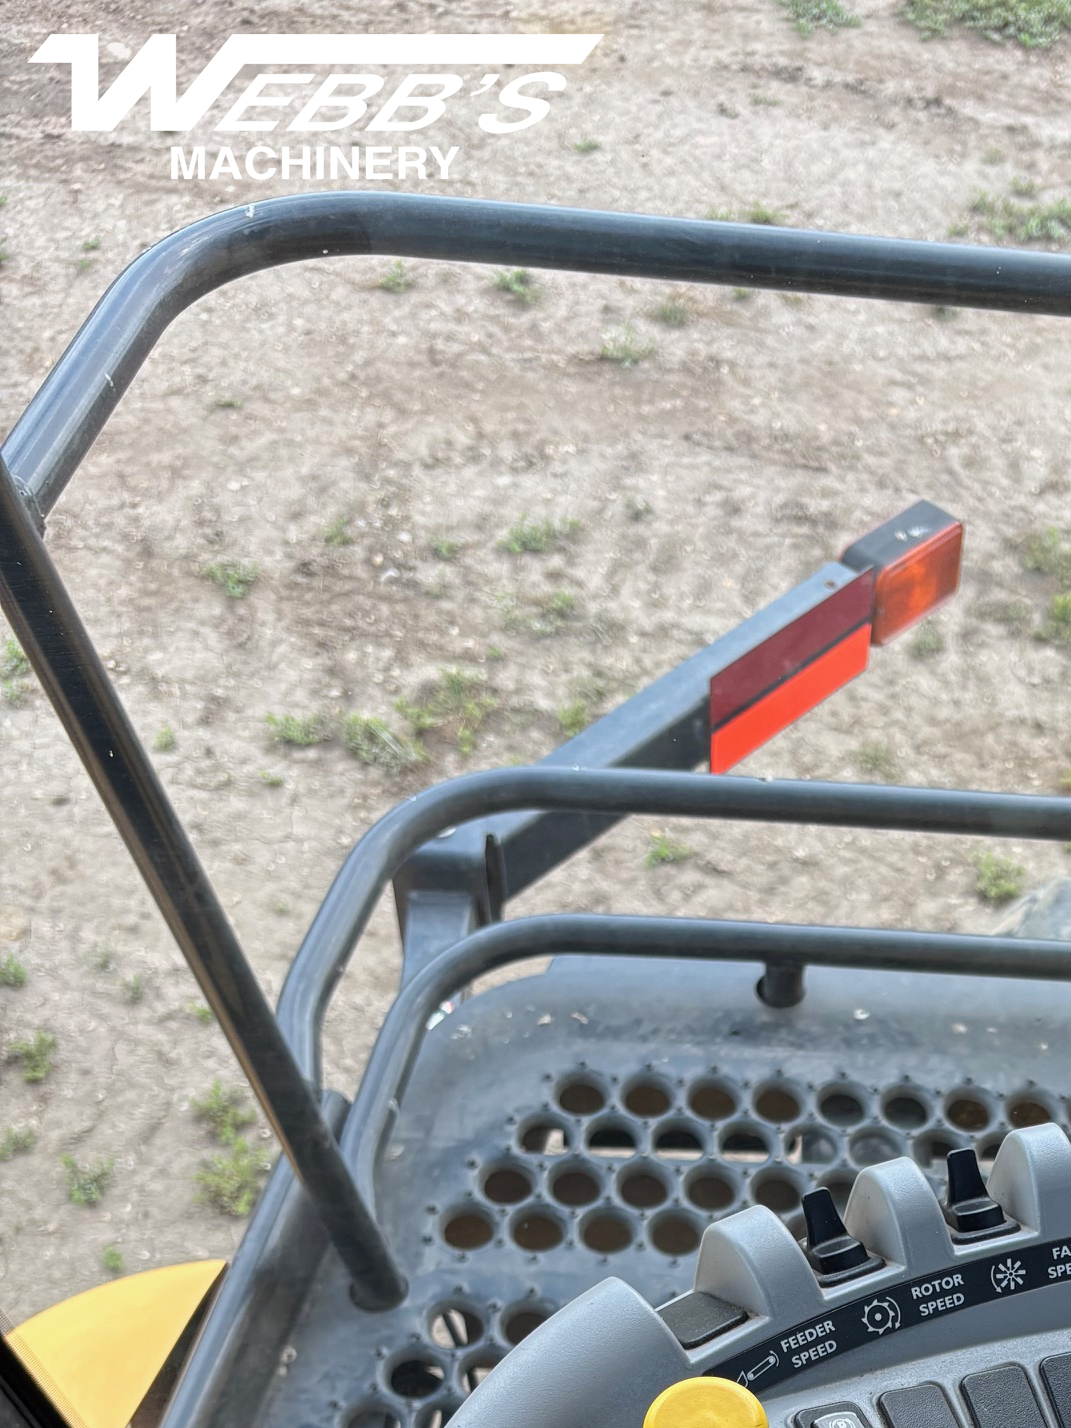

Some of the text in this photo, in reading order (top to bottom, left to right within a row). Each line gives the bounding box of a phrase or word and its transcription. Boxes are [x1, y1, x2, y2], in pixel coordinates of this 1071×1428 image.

[910, 1273, 965, 1300] ROTOR
[919, 1293, 965, 1317] SPEED
[780, 1320, 836, 1353] FEEDER
[791, 1340, 838, 1369] SPEED
